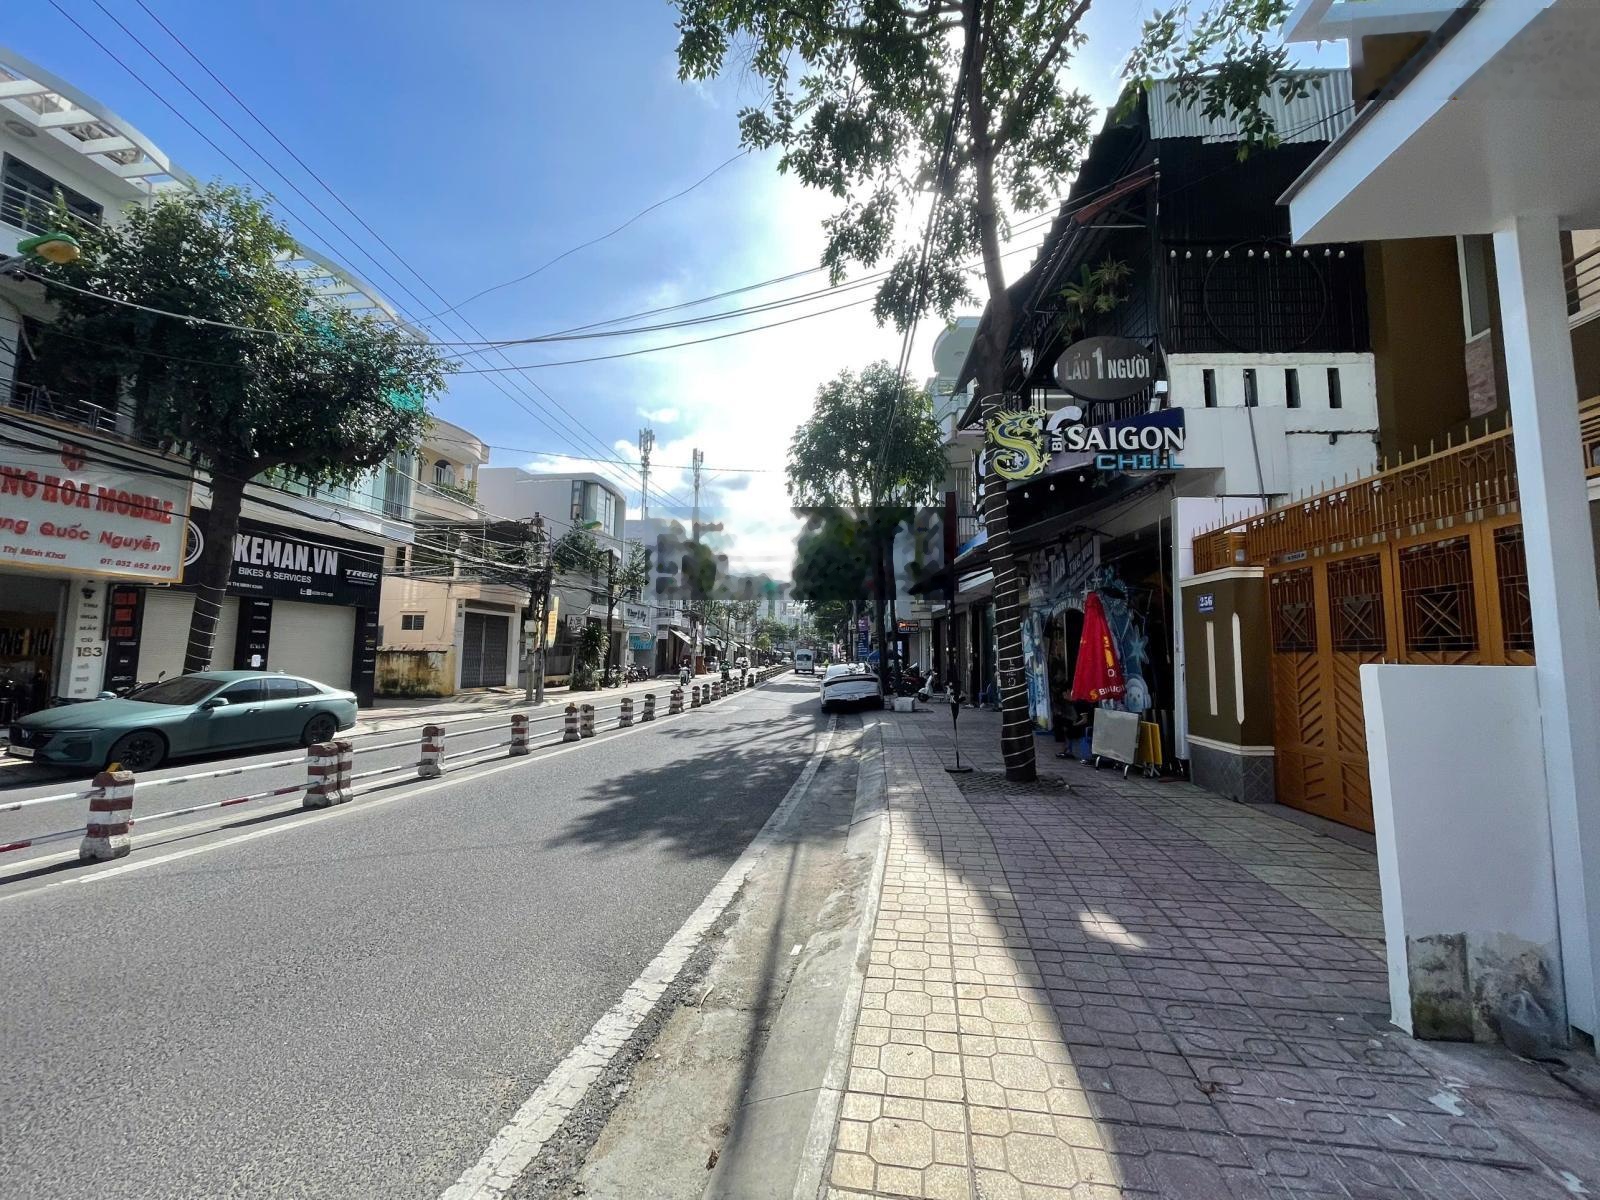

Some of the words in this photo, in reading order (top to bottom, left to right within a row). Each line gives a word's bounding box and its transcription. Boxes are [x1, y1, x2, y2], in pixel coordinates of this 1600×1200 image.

[1092, 347, 1104, 379] 1
[1107, 353, 1151, 379] NGƯỜI
[1066, 424, 1184, 451] SAIGON
[1095, 453, 1185, 470] CHILL
[0, 466, 38, 497] NG
[42, 475, 91, 508] HOA
[96, 486, 174, 524] MOBILE
[39, 522, 91, 541] Quốc
[99, 530, 161, 552] Nguyễn
[232, 533, 338, 576] KEMAN.VN
[238, 566, 264, 578] BIKES
[265, 570, 272, 579] &
[273, 572, 312, 584] SERVICES
[344, 568, 379, 580] TREK
